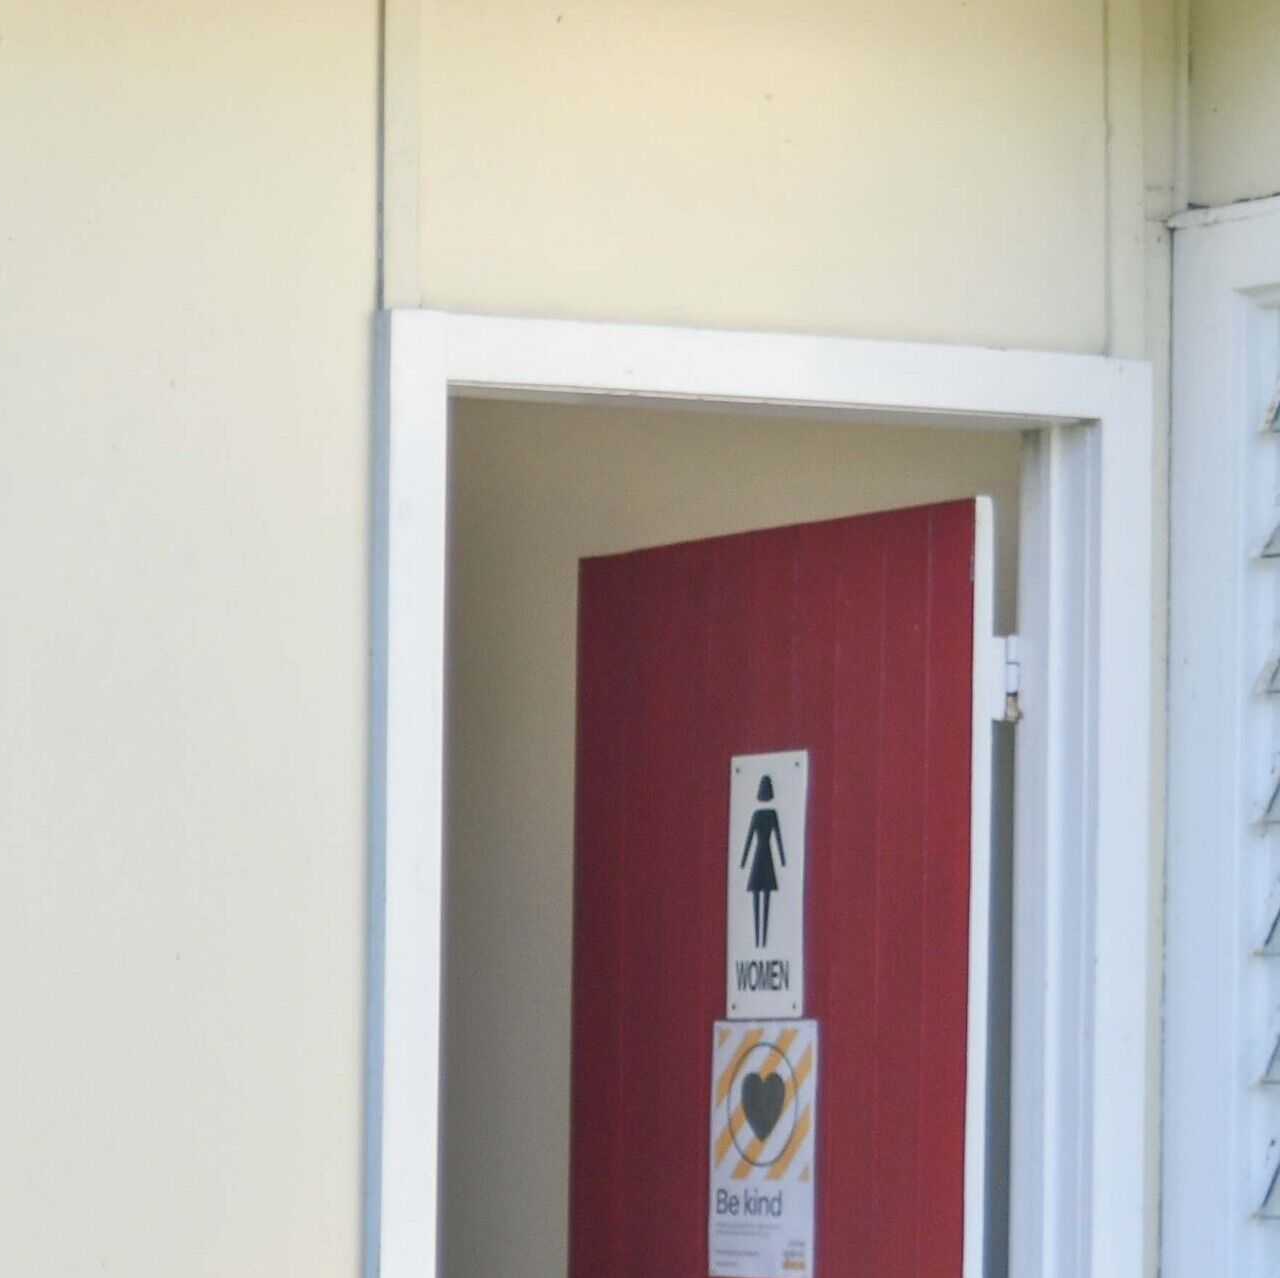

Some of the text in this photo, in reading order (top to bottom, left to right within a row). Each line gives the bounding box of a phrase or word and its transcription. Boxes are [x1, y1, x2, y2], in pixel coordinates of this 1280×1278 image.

[736, 959, 790, 991] WOMEN
[716, 1187, 782, 1217] Be kind
